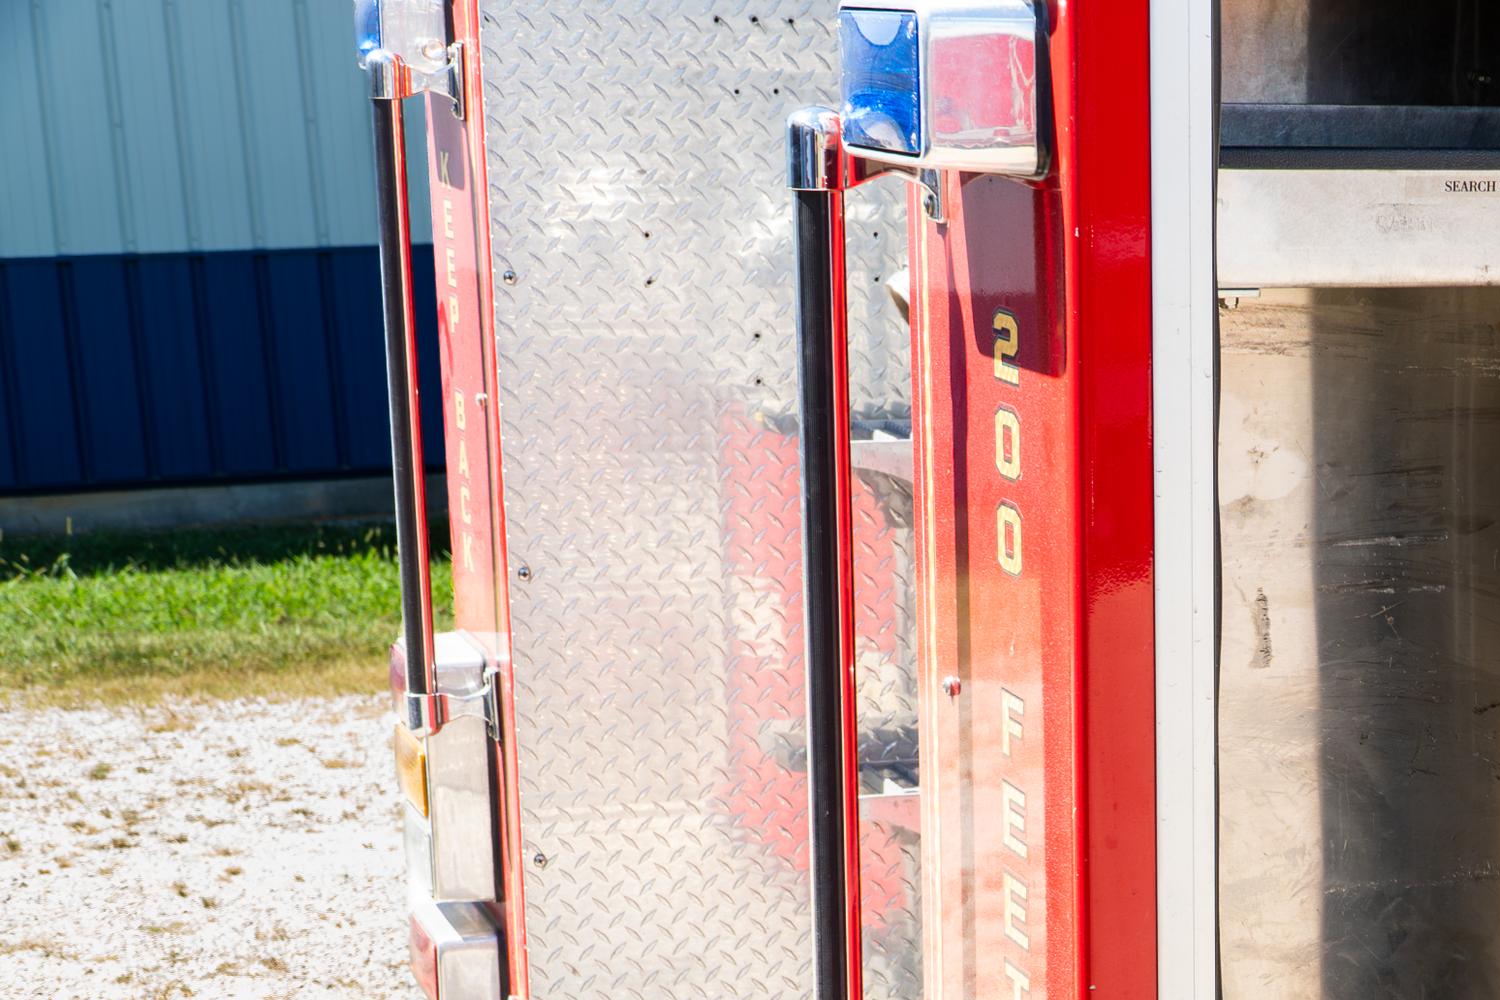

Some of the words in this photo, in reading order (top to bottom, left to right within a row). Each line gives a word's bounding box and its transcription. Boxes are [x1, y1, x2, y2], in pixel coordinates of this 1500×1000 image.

[1445, 180, 1496, 193] SEARCH
[440, 151, 460, 334] KEEP
[454, 388, 475, 573] BACK
[991, 304, 1023, 578] 200
